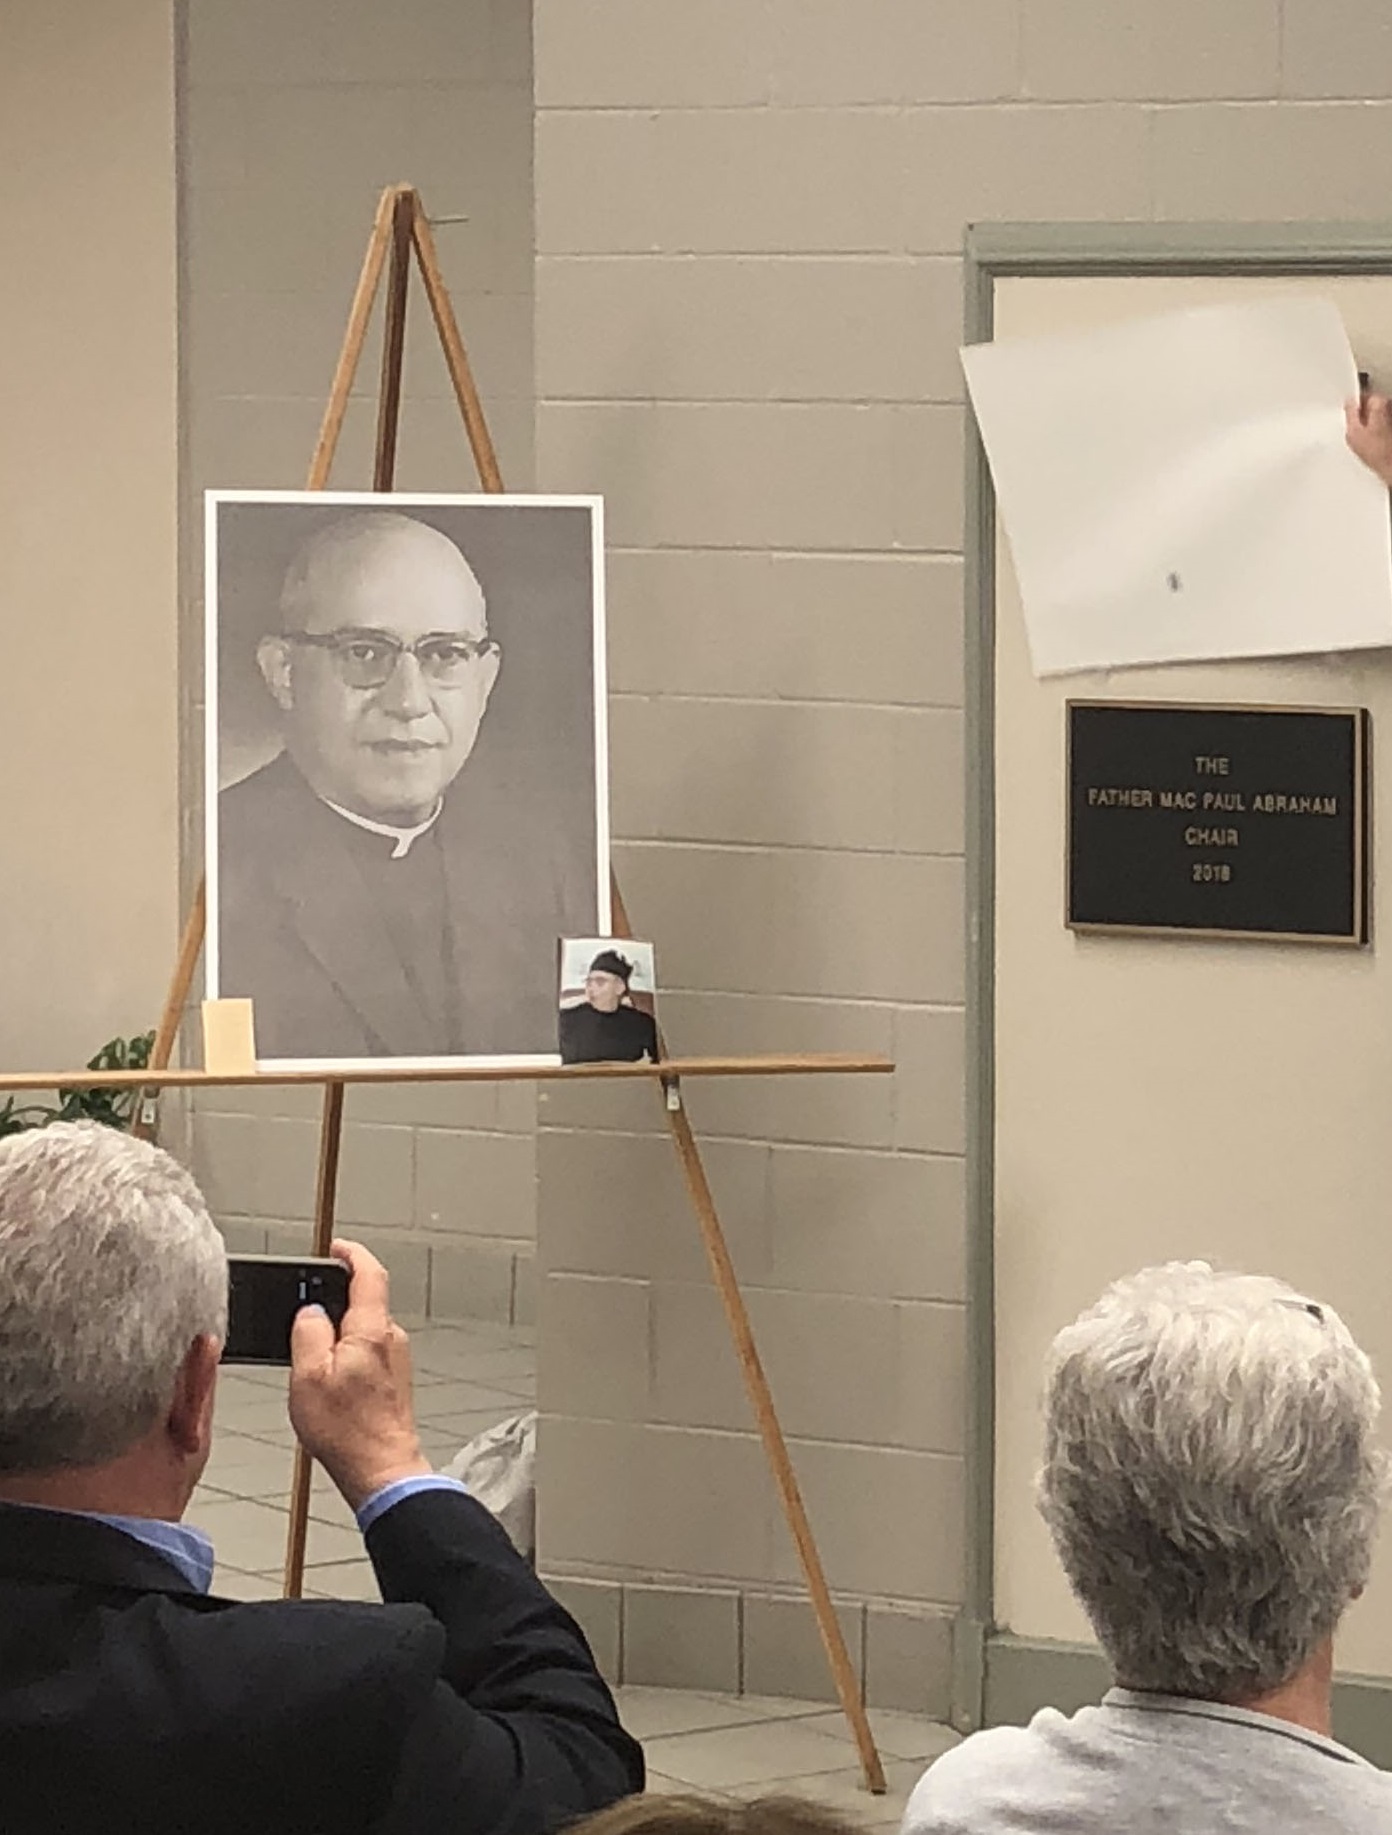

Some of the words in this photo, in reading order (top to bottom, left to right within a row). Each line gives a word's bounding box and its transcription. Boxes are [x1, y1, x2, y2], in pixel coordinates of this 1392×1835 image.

[1195, 756, 1229, 775] THE
[1088, 788, 1152, 807] FATHER
[1160, 791, 1196, 809] MAC
[1203, 791, 1245, 811] PAUL
[1253, 794, 1336, 815] ABRAHAM
[1185, 826, 1239, 846] CHAIR
